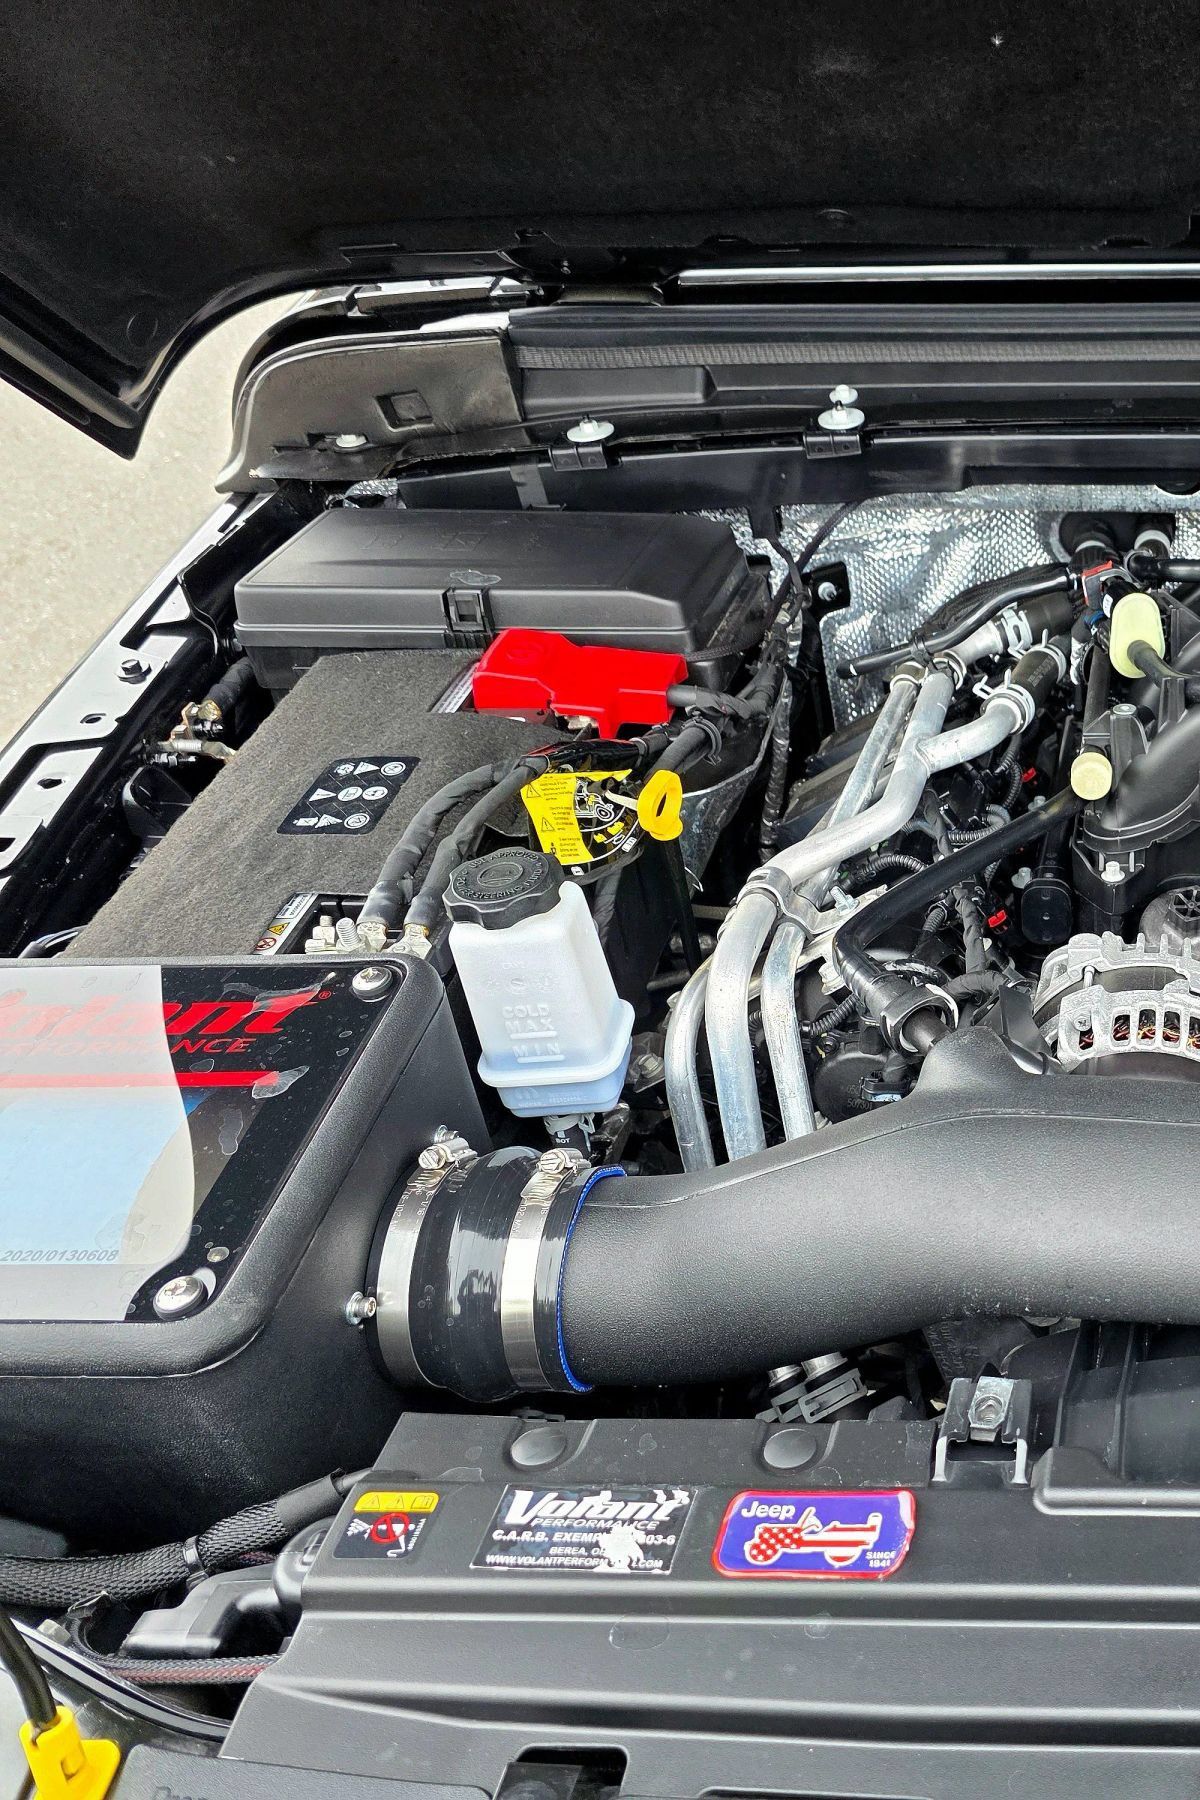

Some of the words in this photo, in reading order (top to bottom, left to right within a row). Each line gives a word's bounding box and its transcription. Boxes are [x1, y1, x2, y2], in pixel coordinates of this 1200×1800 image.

[491, 850, 540, 862] APPROVED
[0, 985, 317, 1036] olant
[502, 1004, 550, 1019] COLD
[504, 1019, 555, 1034] MAX
[512, 1042, 561, 1058] MIN
[1, 1249, 119, 1262] 2020/0130608
[504, 1490, 690, 1525] Volant
[741, 1501, 796, 1520] Jeep
[492, 1529, 549, 1543] C.A.R.B.
[865, 1551, 896, 1560] SINCE
[869, 1559, 891, 1568] 1941
